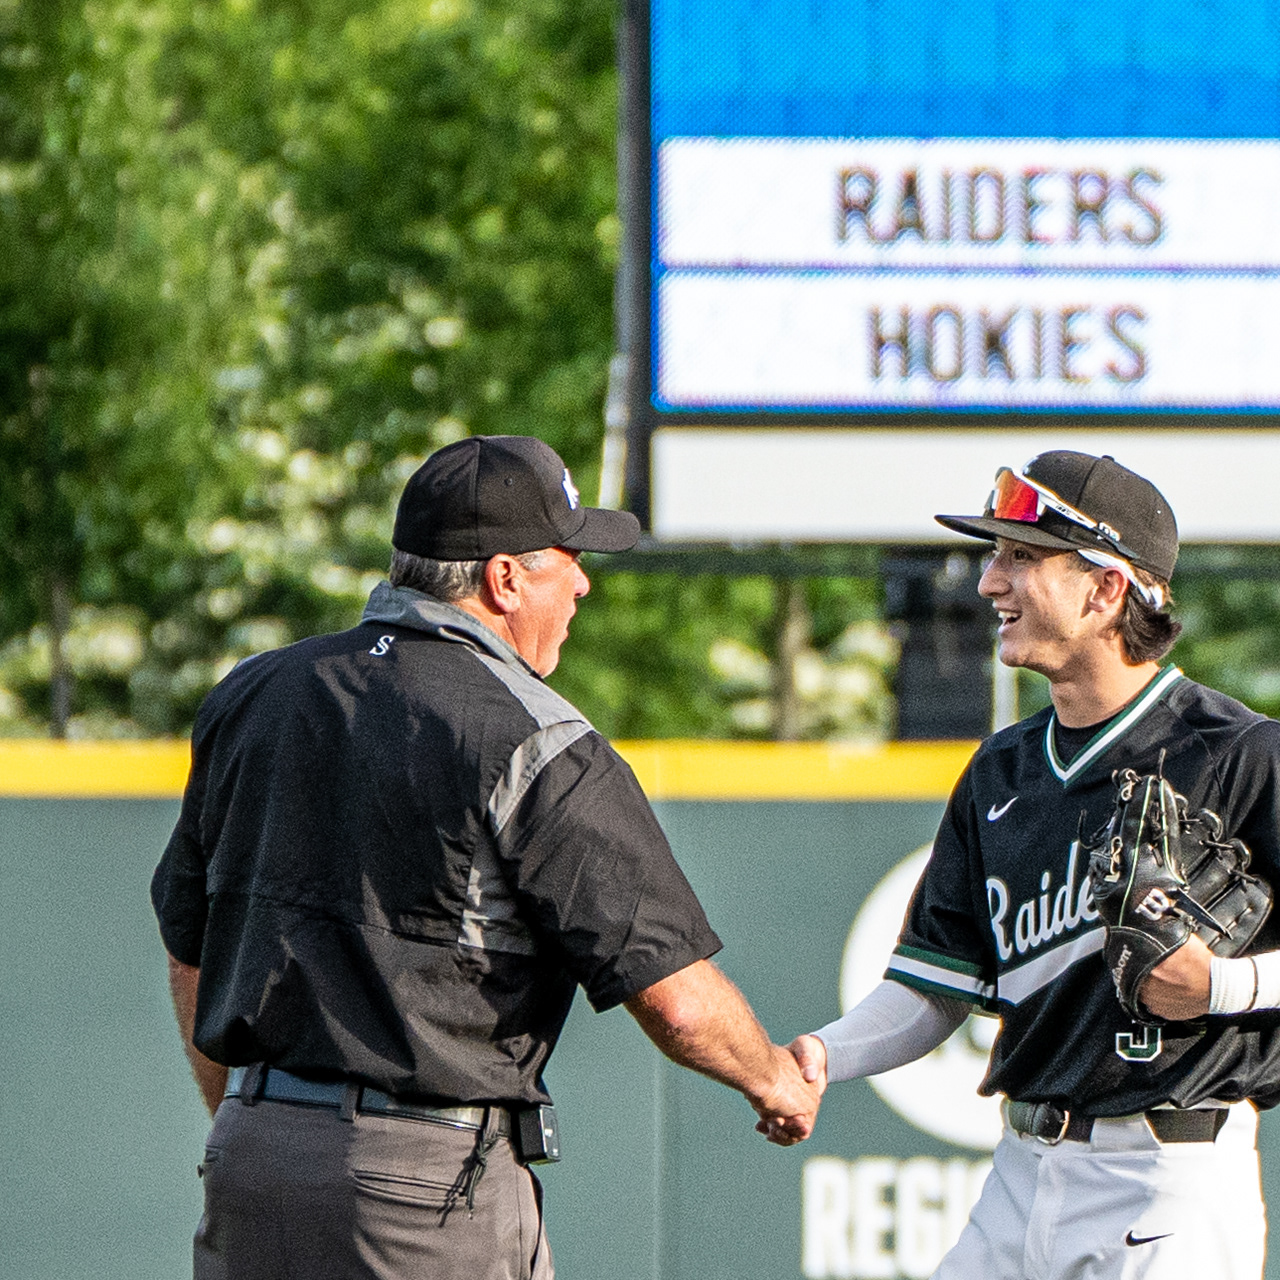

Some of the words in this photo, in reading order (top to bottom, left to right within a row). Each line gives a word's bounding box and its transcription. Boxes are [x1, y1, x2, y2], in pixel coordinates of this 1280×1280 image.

[834, 166, 1165, 247] RAIDERS
[867, 304, 1149, 388] HOKIES
[985, 838, 1101, 963] Raide
